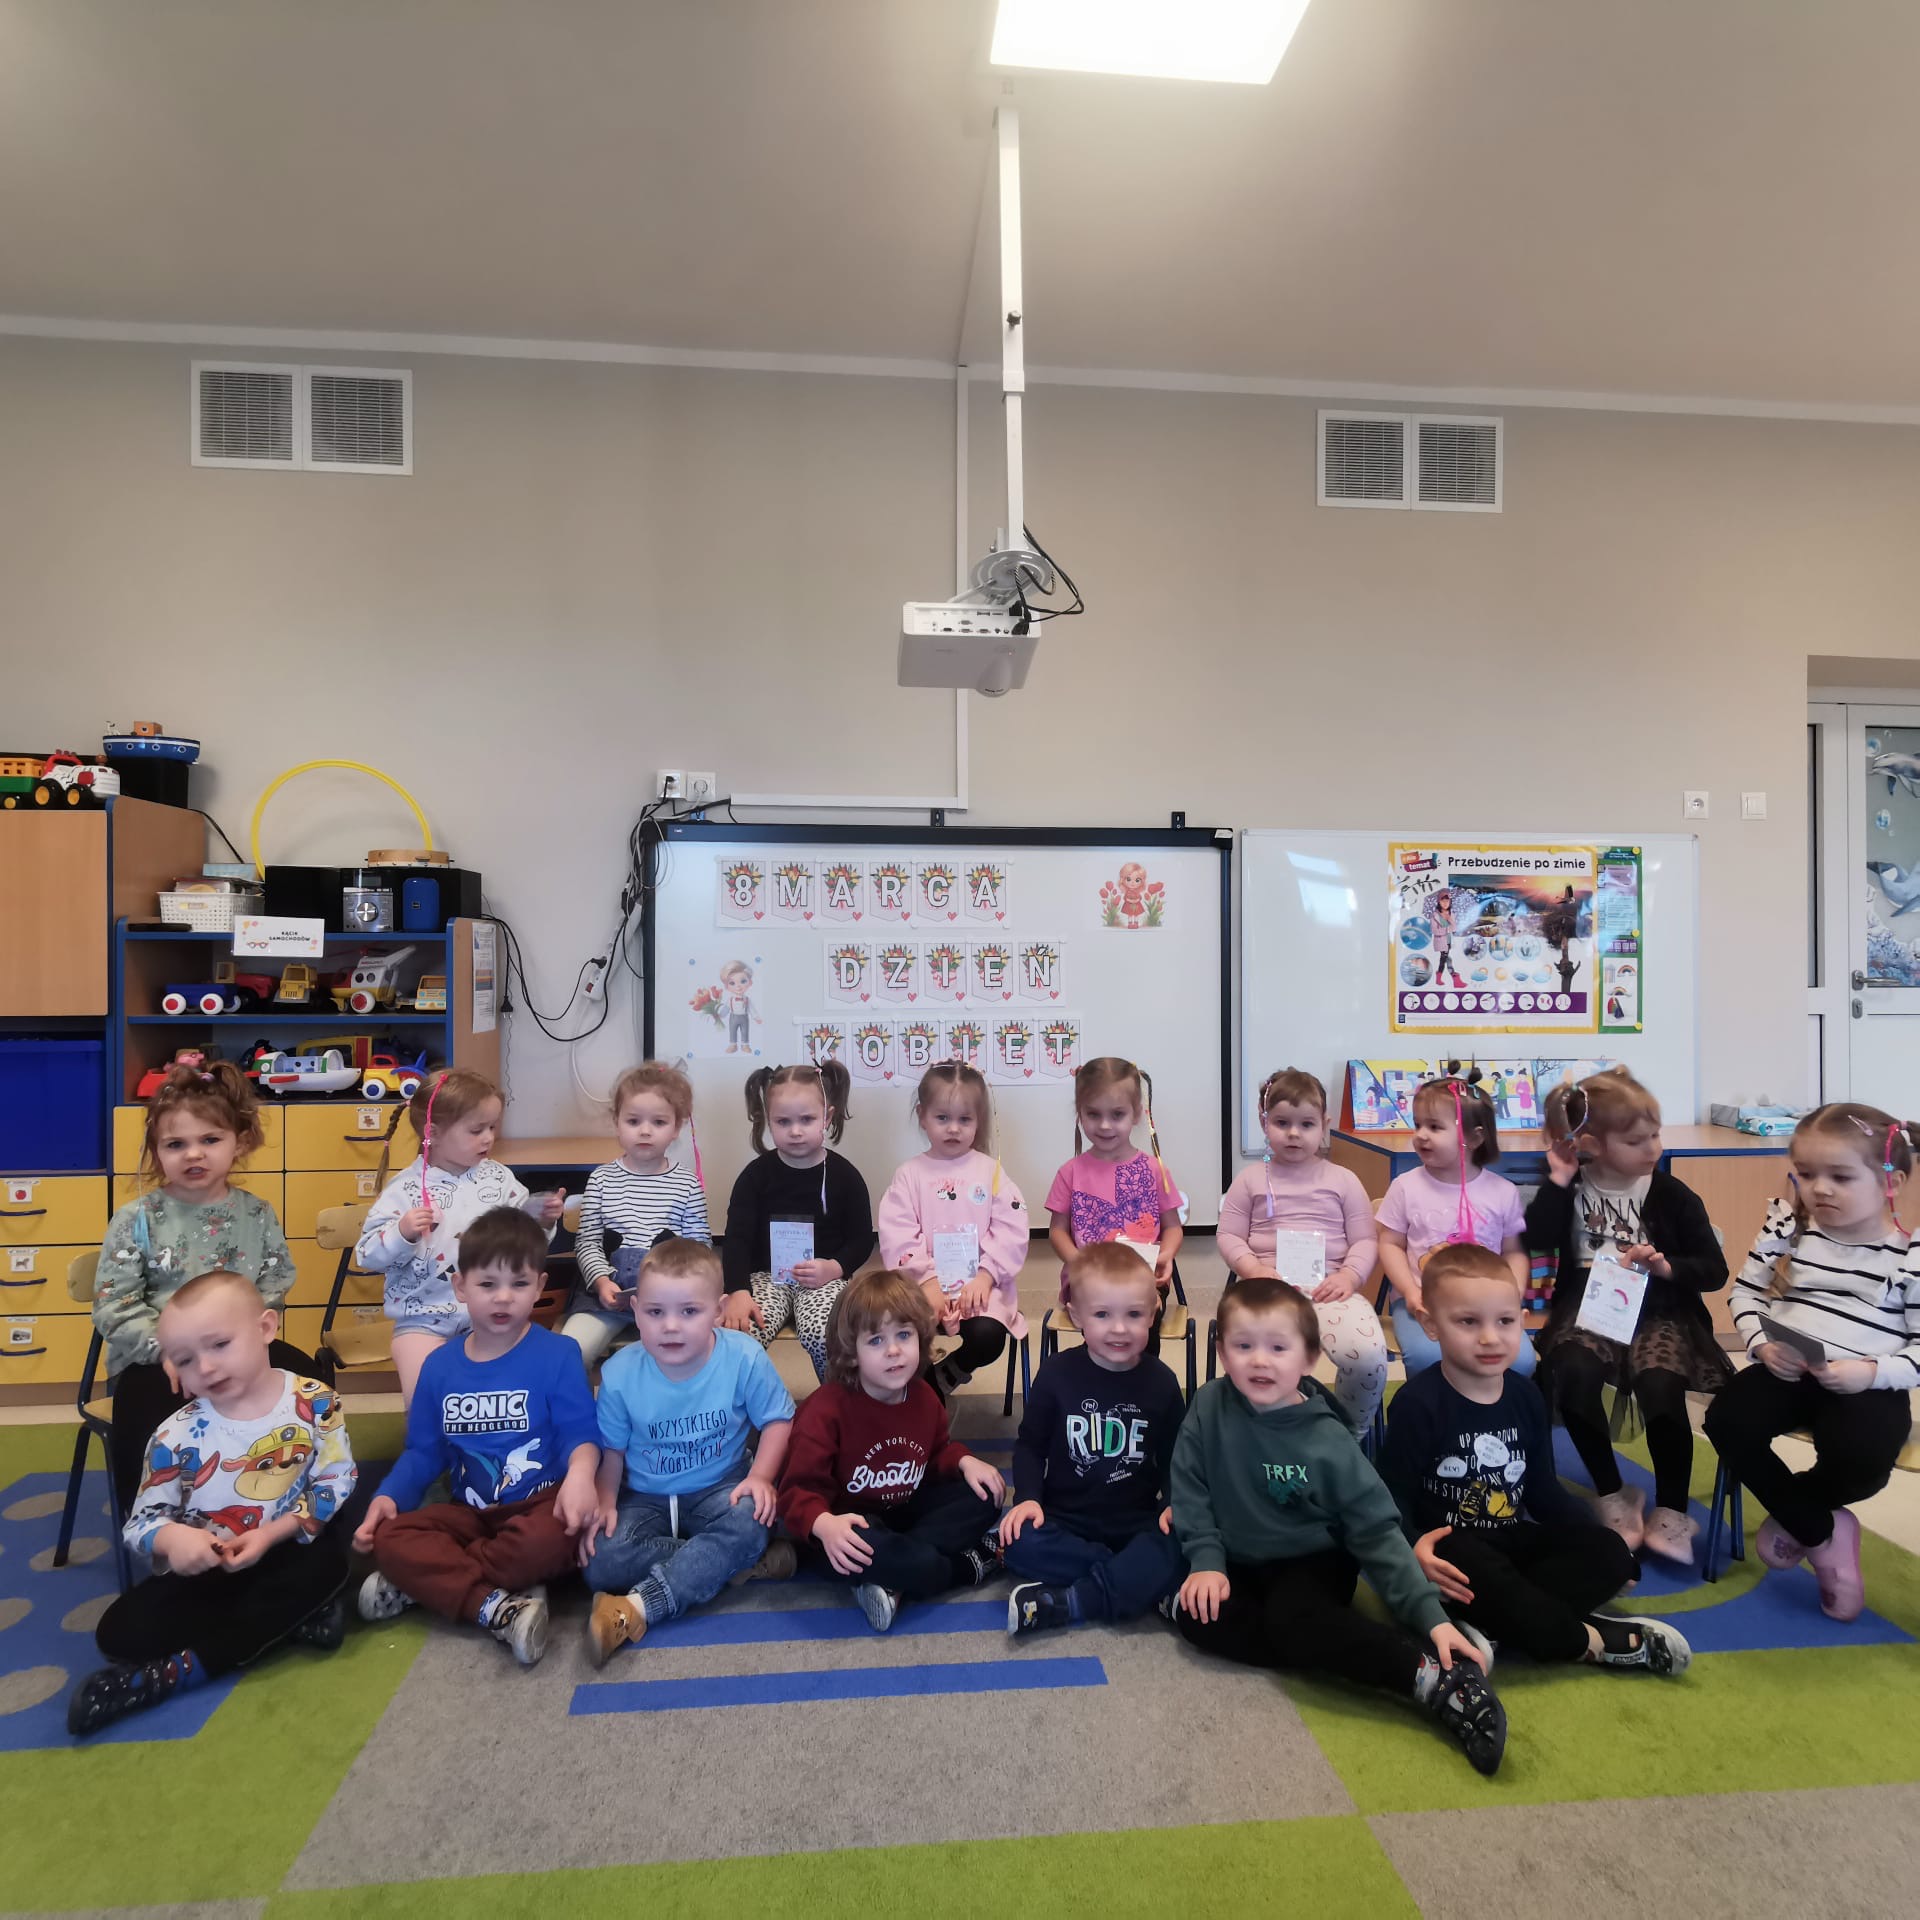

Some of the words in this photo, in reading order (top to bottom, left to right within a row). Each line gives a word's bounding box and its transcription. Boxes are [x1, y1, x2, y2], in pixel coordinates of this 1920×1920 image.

[1448, 856, 1531, 868] Przebudzenie
[1534, 859, 1550, 870] po
[1553, 858, 1586, 869] zimie
[733, 874, 753, 907] 8
[778, 874, 998, 908] MARCA
[839, 946, 1052, 989] DZIEŃ
[813, 1032, 1071, 1068] KOBIET
[445, 1392, 527, 1420] SONIC
[446, 1423, 462, 1433] THE
[467, 1421, 526, 1432] HEDGEHOG
[648, 1409, 728, 1440] WSZYSTKIEGO
[1066, 1412, 1149, 1458] RIDE
[864, 1442, 883, 1460] NEW
[885, 1436, 907, 1447] YORK
[1459, 1433, 1471, 1448] UP
